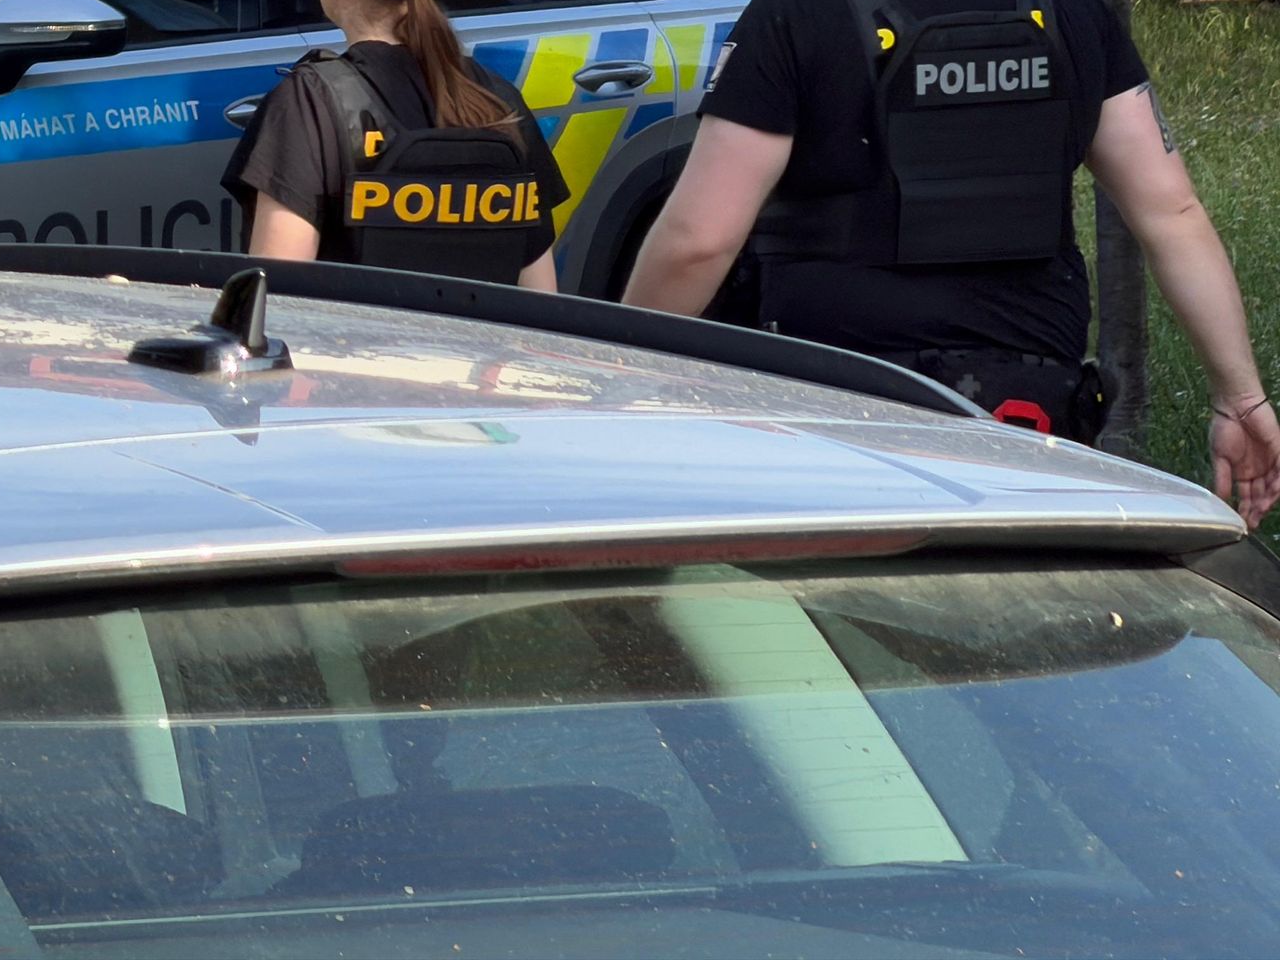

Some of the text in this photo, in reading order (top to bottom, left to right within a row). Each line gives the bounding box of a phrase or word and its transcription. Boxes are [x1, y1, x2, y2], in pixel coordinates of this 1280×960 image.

[916, 56, 1050, 96] POLICIE
[85, 111, 100, 133] A
[105, 98, 200, 130] CHRÁNIT
[351, 181, 540, 223] POLICIE
